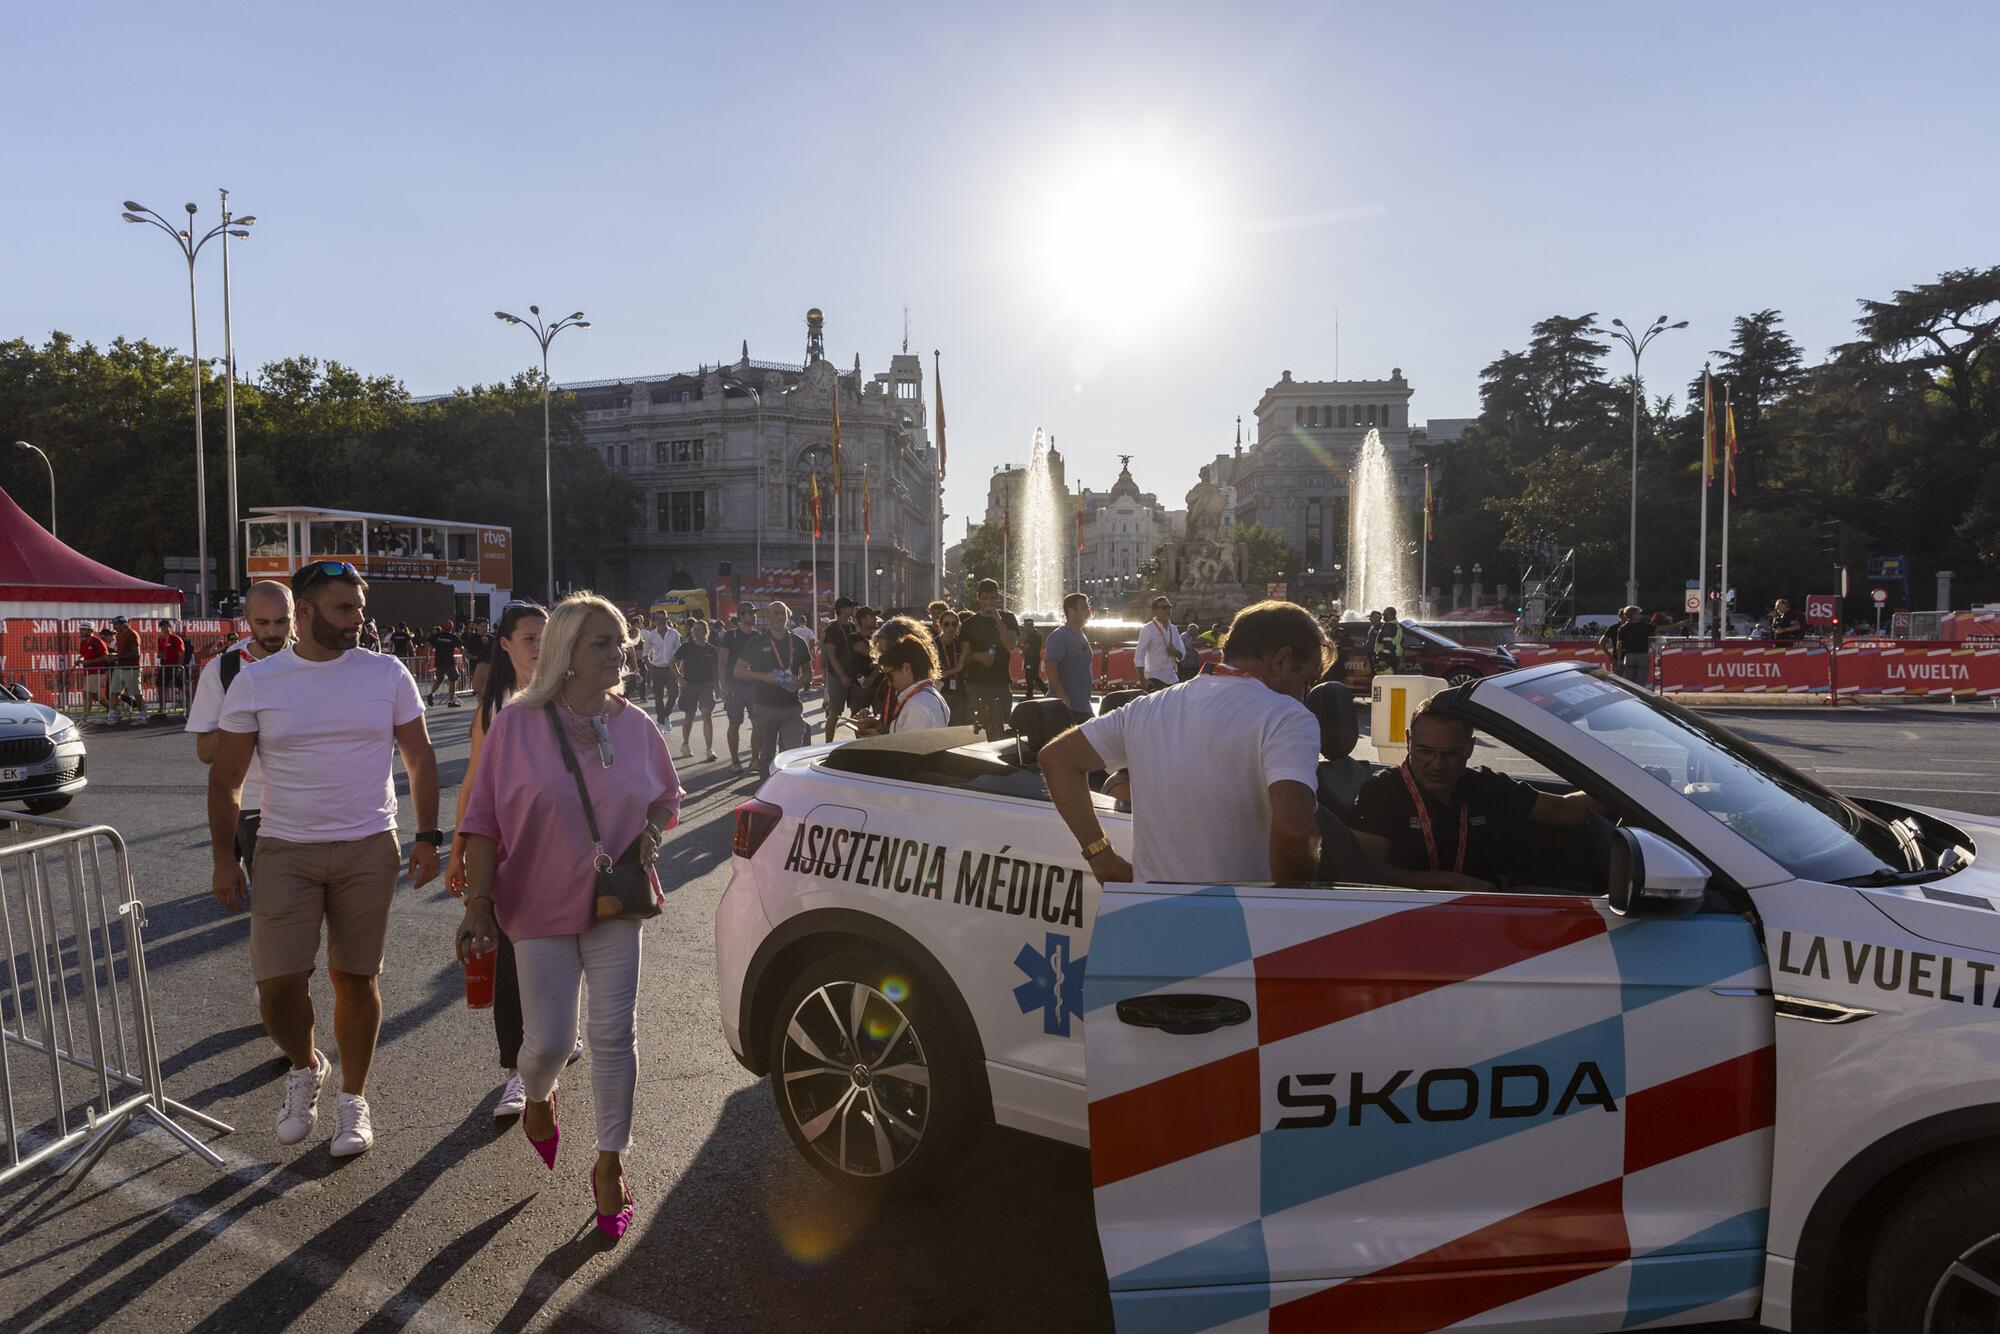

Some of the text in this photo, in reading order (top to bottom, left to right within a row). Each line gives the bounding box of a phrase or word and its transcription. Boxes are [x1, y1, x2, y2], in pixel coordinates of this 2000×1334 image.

[484, 530, 506, 548] rtve
[1809, 602, 1833, 618] as
[32, 619, 58, 633] SAN
[139, 619, 221, 633] LA CPERONA
[1708, 663, 1782, 678] LA VUELTA
[1887, 663, 1970, 680] LA VUELTA
[784, 822, 1085, 929] ASISTENCIA MÉDICA
[1778, 931, 1831, 980] LA
